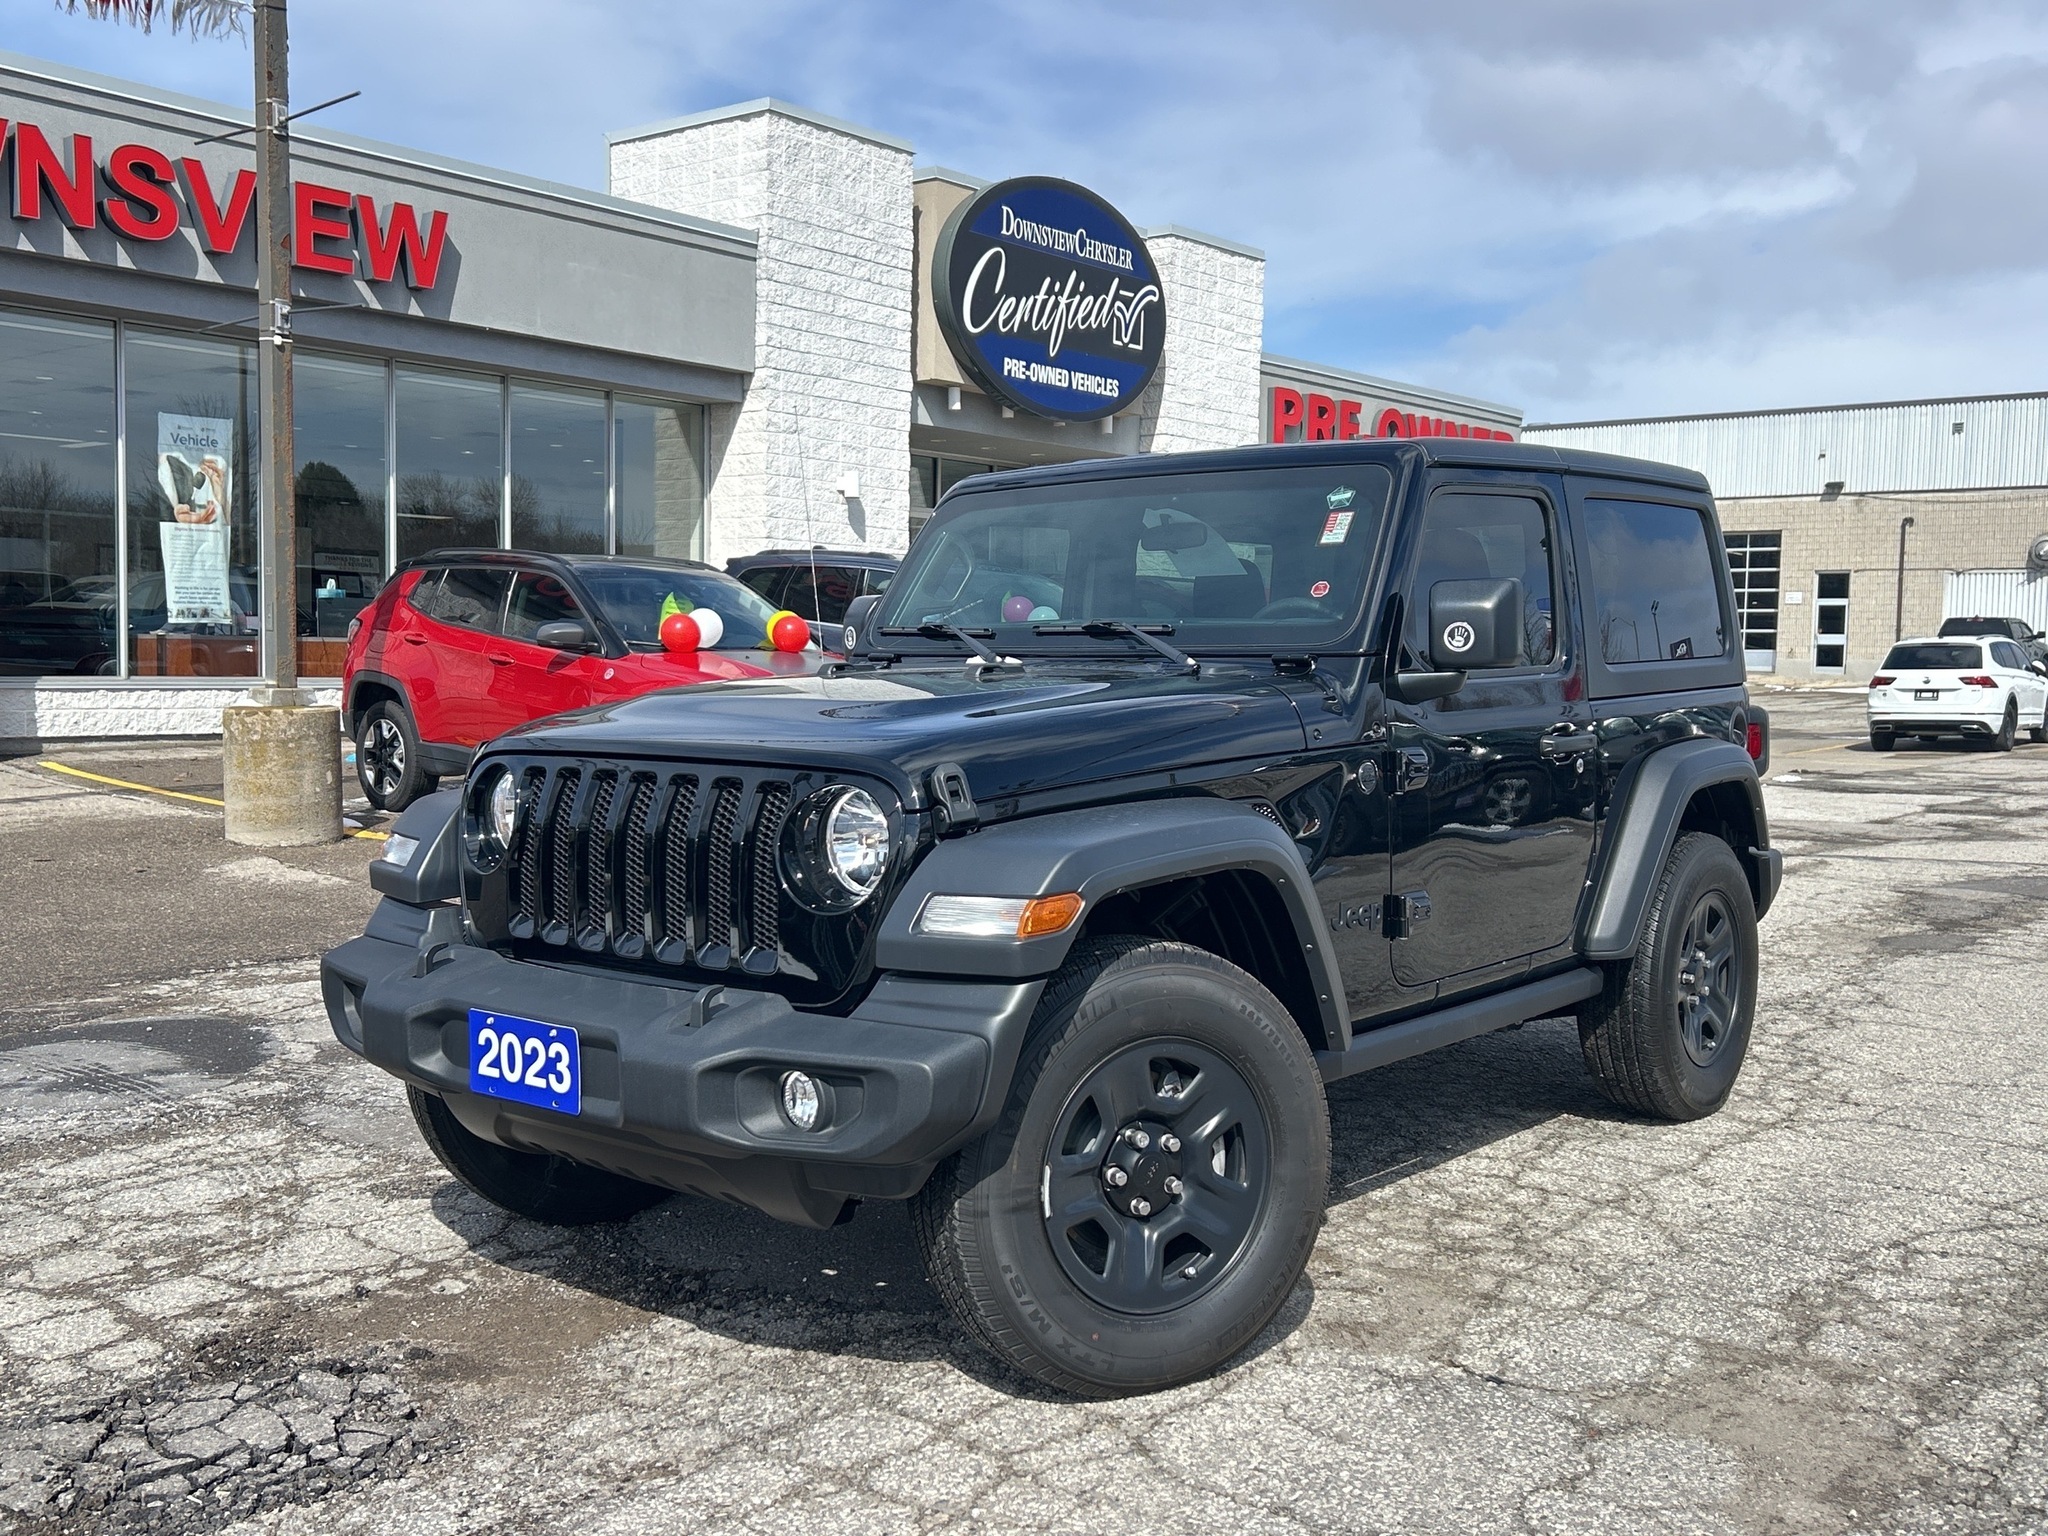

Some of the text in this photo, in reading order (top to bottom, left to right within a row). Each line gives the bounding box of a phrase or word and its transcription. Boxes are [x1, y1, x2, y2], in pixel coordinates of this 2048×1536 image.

[0, 117, 449, 290] NSVEW
[962, 247, 1120, 357] Certified
[1003, 357, 1120, 398] PRE-OWNED VEHICLES
[170, 432, 219, 448] Vehicle
[1331, 901, 1382, 932] Jeep
[477, 1027, 572, 1094] 2023
[1016, 990, 1121, 1104] MICHELIN
